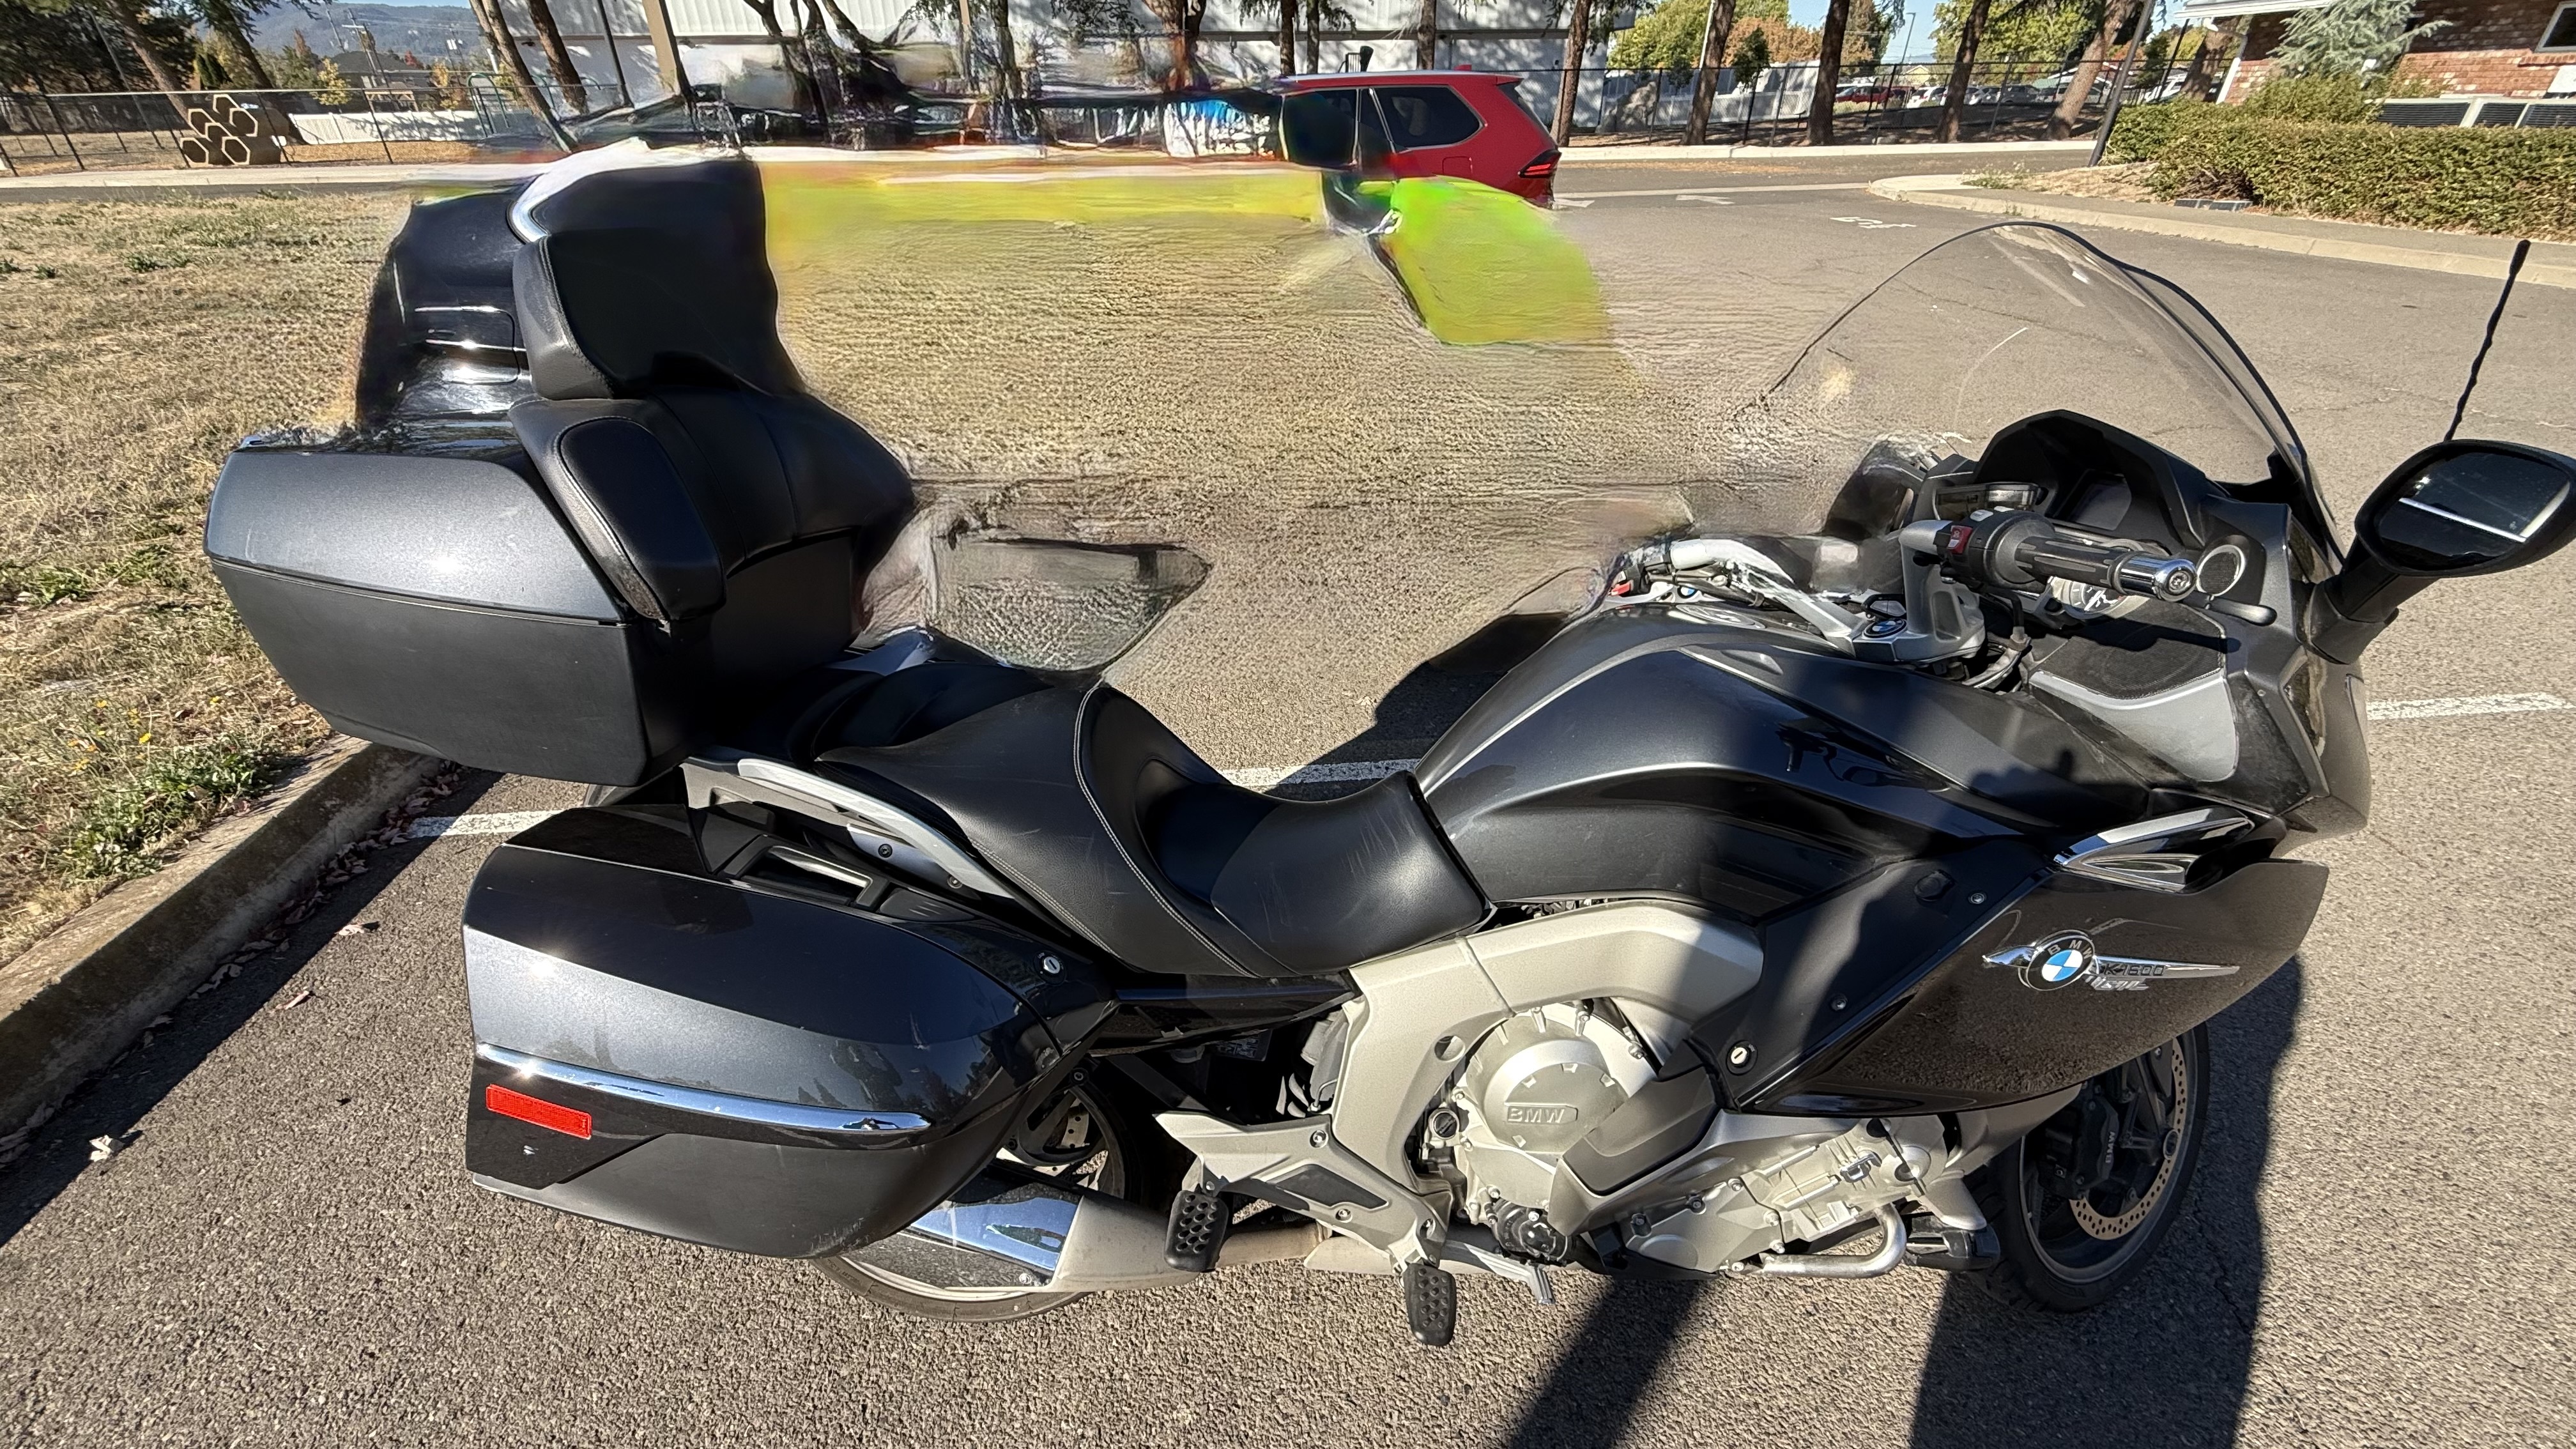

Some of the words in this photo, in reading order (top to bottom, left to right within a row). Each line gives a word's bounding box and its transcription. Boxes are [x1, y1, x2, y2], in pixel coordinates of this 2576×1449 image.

[2048, 940, 2092, 960] BMW
[1508, 1108, 1565, 1123] BMW
[2105, 1131, 2115, 1163] BMW
